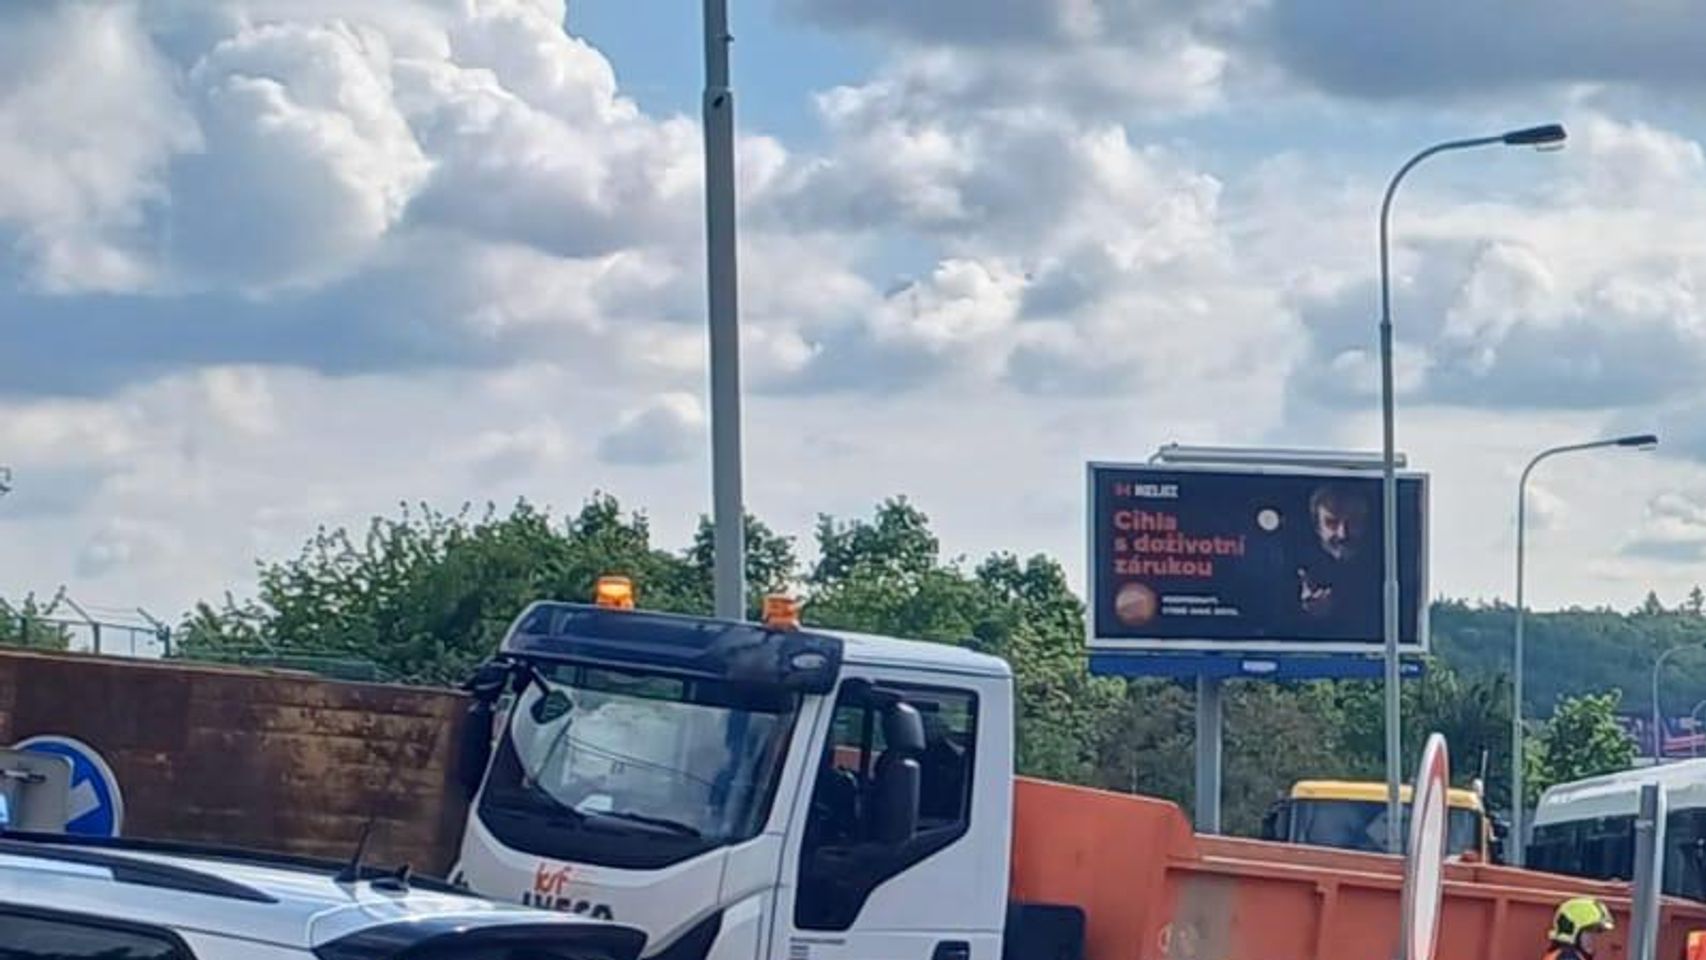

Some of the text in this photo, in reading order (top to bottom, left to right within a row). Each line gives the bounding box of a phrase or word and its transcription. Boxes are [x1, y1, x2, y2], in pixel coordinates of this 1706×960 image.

[1114, 510, 1177, 531] Cihla
[1114, 532, 1246, 556] s doživotní
[1114, 554, 1213, 577] zárukou
